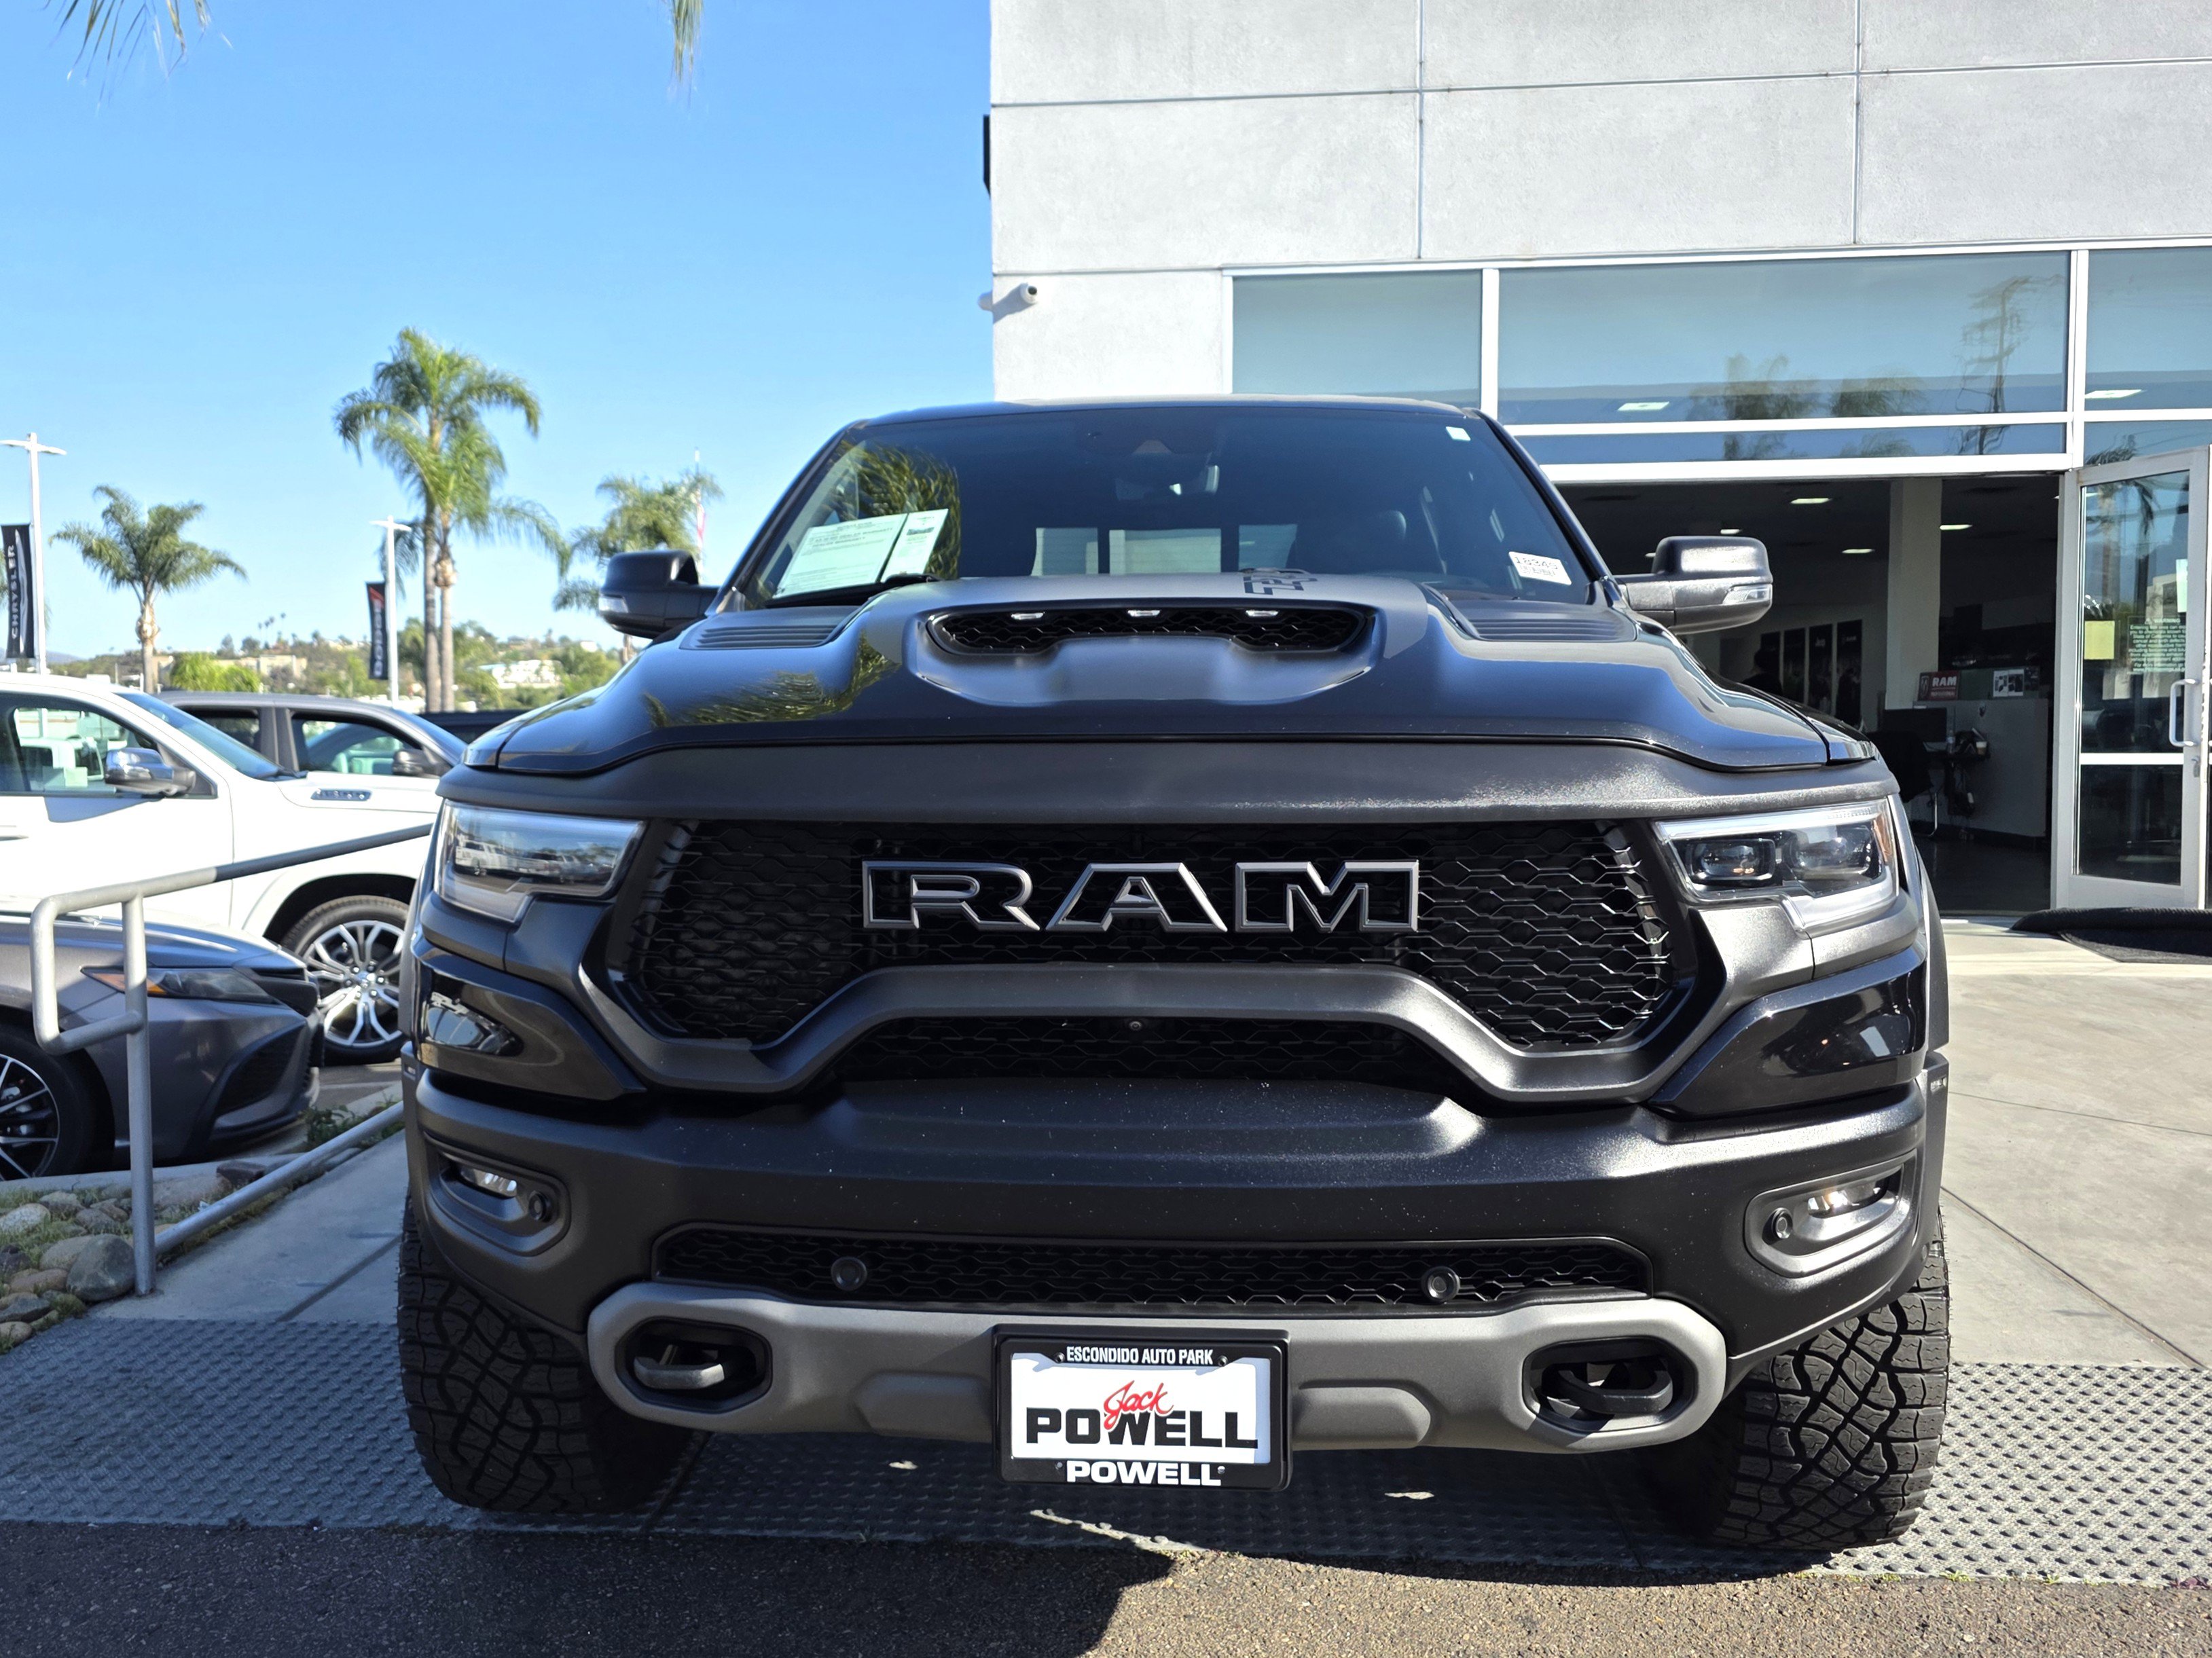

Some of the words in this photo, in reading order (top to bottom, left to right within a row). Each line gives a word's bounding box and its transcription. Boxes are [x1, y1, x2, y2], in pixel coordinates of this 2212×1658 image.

[7, 545, 18, 640] CHRYSLER
[1932, 676, 1957, 687] RAM
[861, 860, 1420, 933] RAM
[1066, 1346, 1140, 1364] ESCONDIDO
[1142, 1347, 1176, 1365] AUTO
[1178, 1348, 1214, 1365] PARK
[1104, 1380, 1174, 1431] Jack
[1026, 1407, 1258, 1449] POWELL
[1066, 1460, 1221, 1486] POWELL
